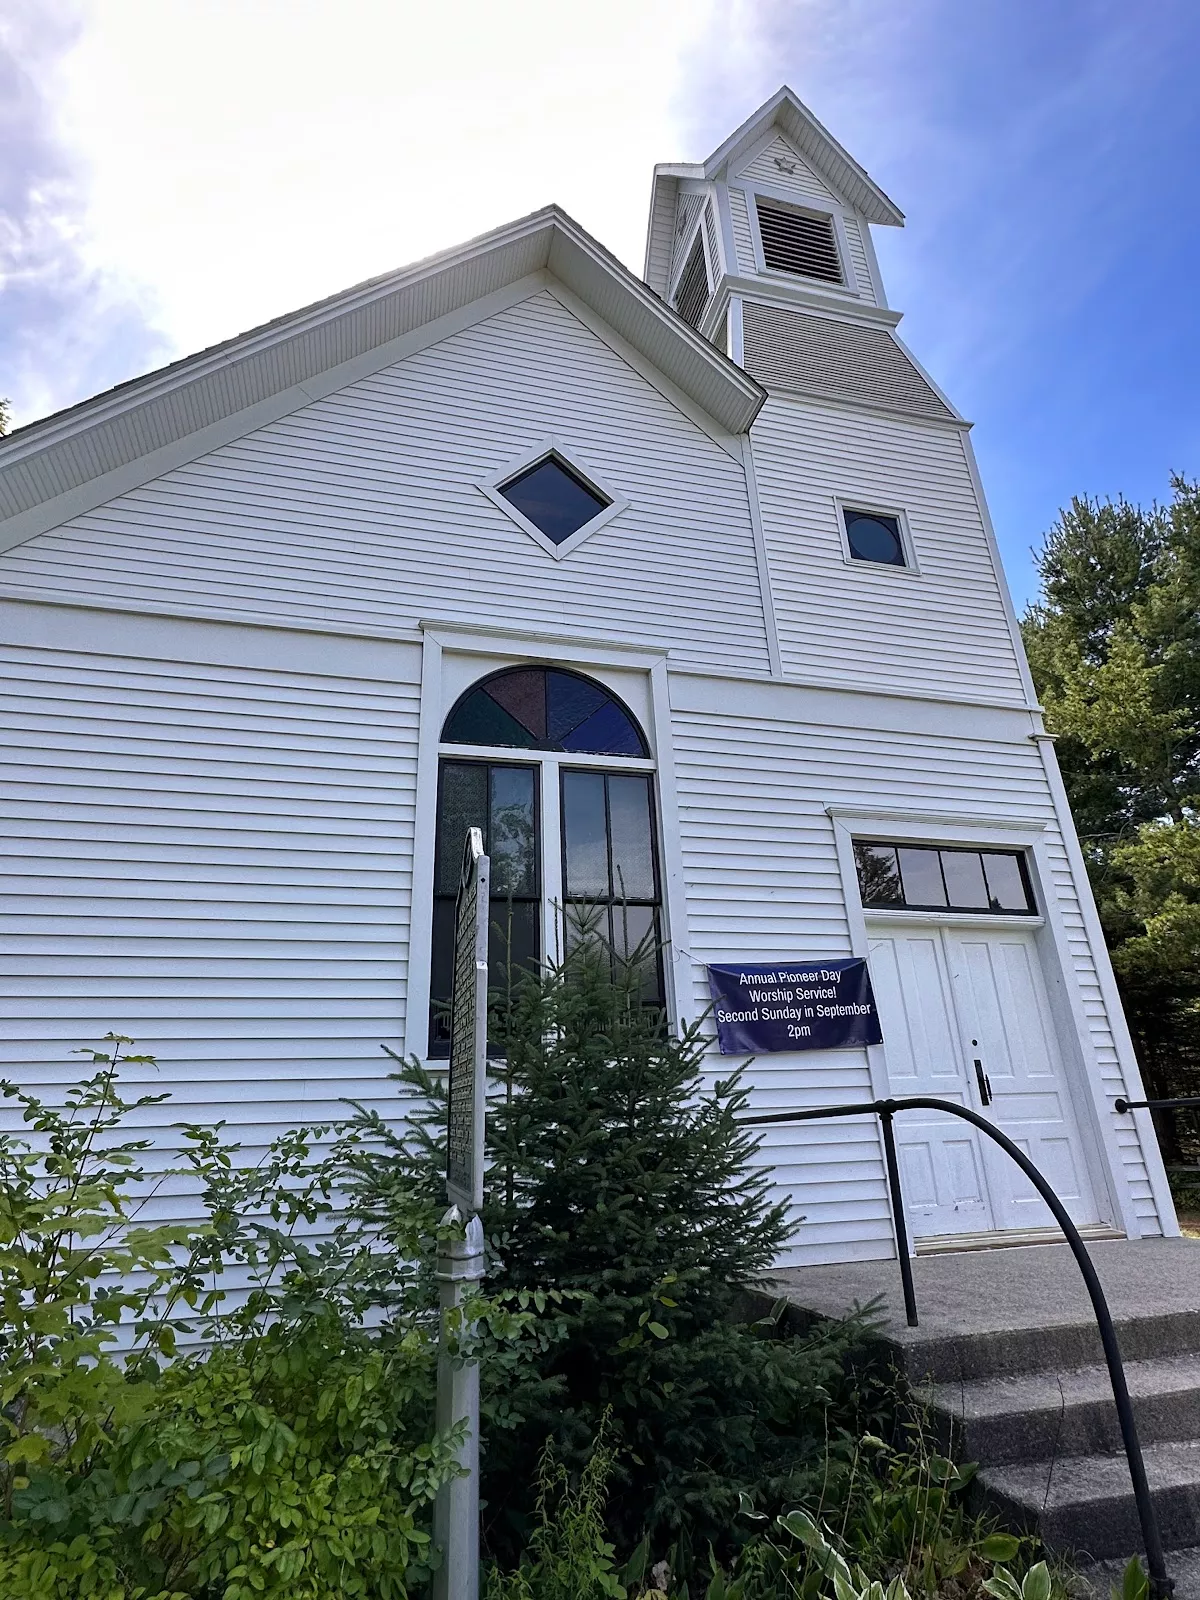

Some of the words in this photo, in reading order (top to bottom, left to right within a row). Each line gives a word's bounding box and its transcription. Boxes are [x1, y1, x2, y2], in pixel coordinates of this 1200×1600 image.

[739, 972, 777, 985] Annual
[778, 971, 819, 983] Pioneer
[821, 970, 841, 984] Day
[749, 988, 793, 1003] Worship
[796, 986, 837, 1000] Service!
[717, 1007, 759, 1023] Second
[761, 1005, 802, 1022] Sunday
[804, 1005, 814, 1018] in
[816, 1003, 871, 1019] September
[787, 1024, 811, 1039] 2pm
